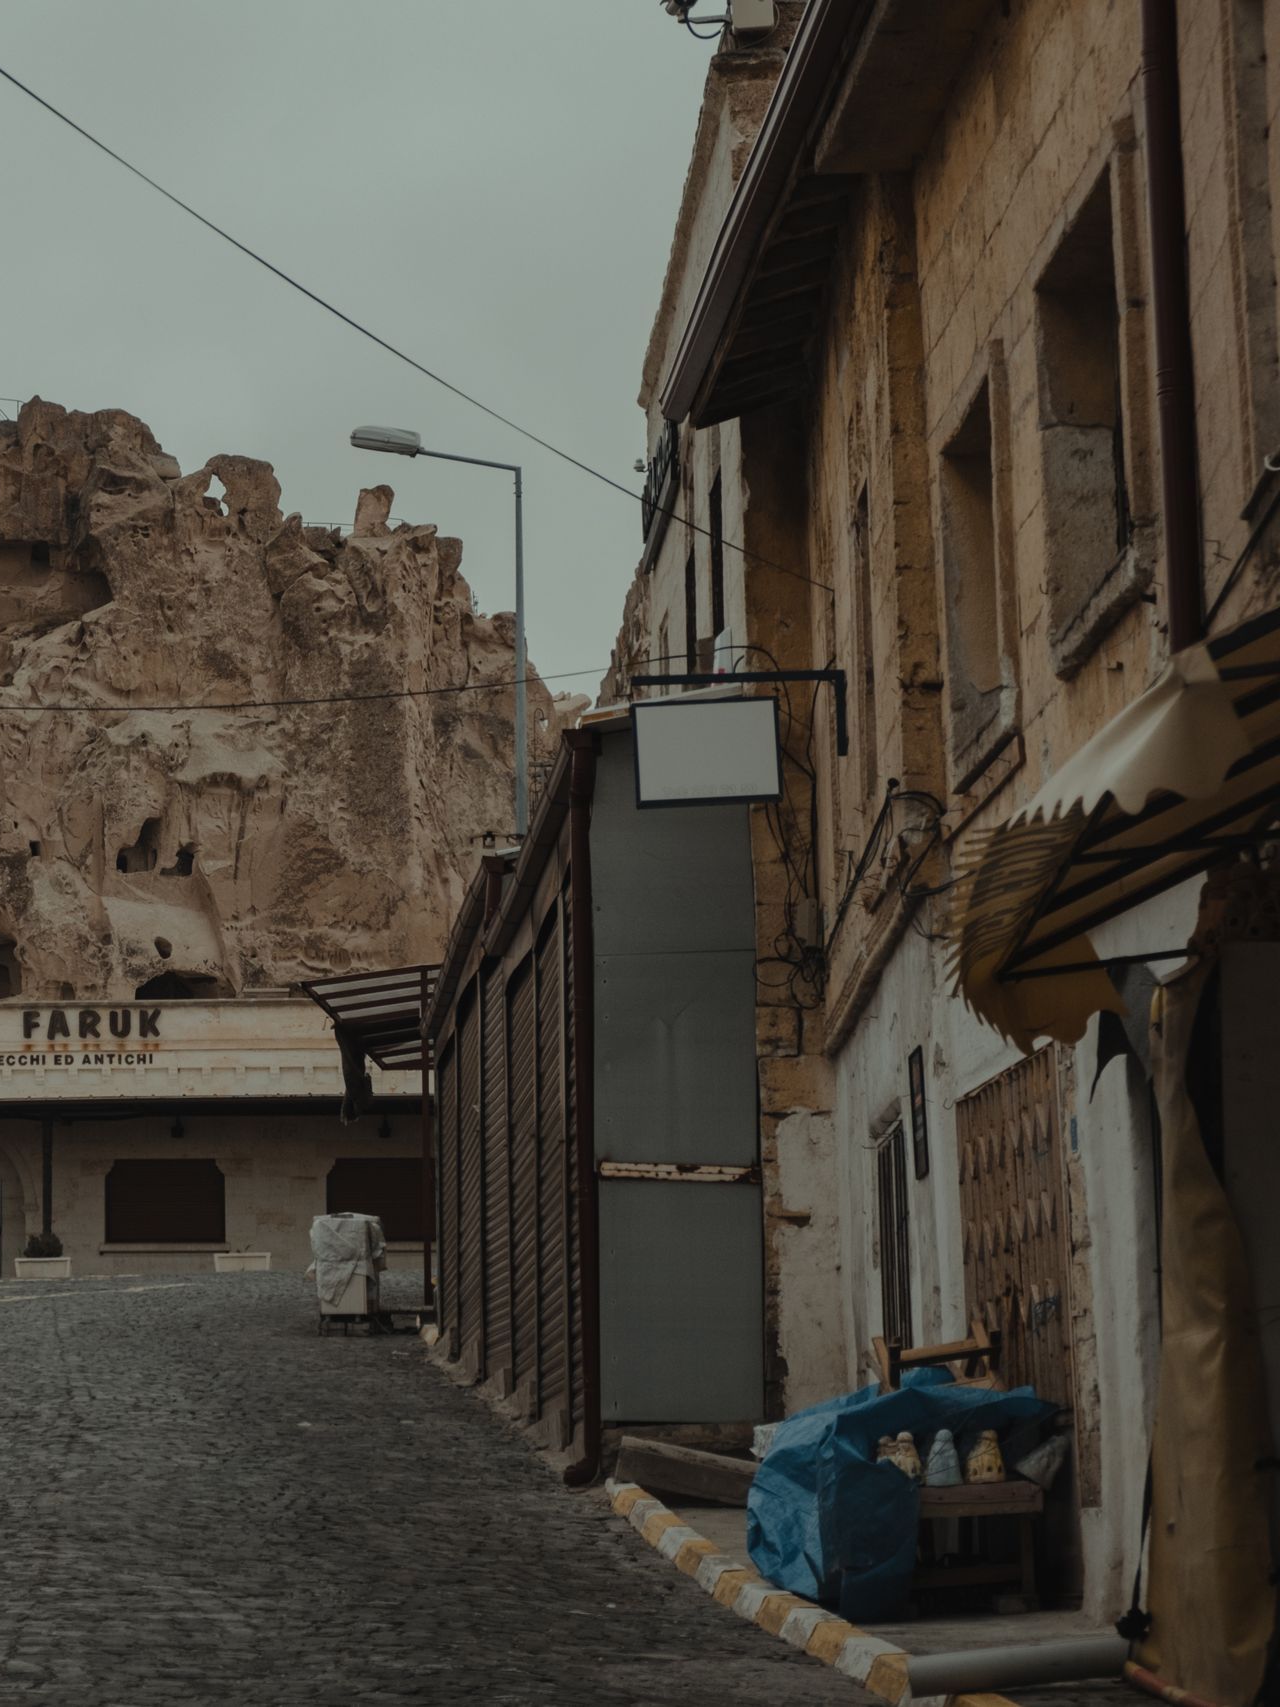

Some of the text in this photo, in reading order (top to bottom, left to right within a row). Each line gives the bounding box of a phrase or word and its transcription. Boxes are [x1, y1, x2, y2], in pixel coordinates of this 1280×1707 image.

[23, 1008, 161, 1040] FARUK
[54, 1054, 74, 1065] ED
[82, 1053, 153, 1065] ANTICHI
